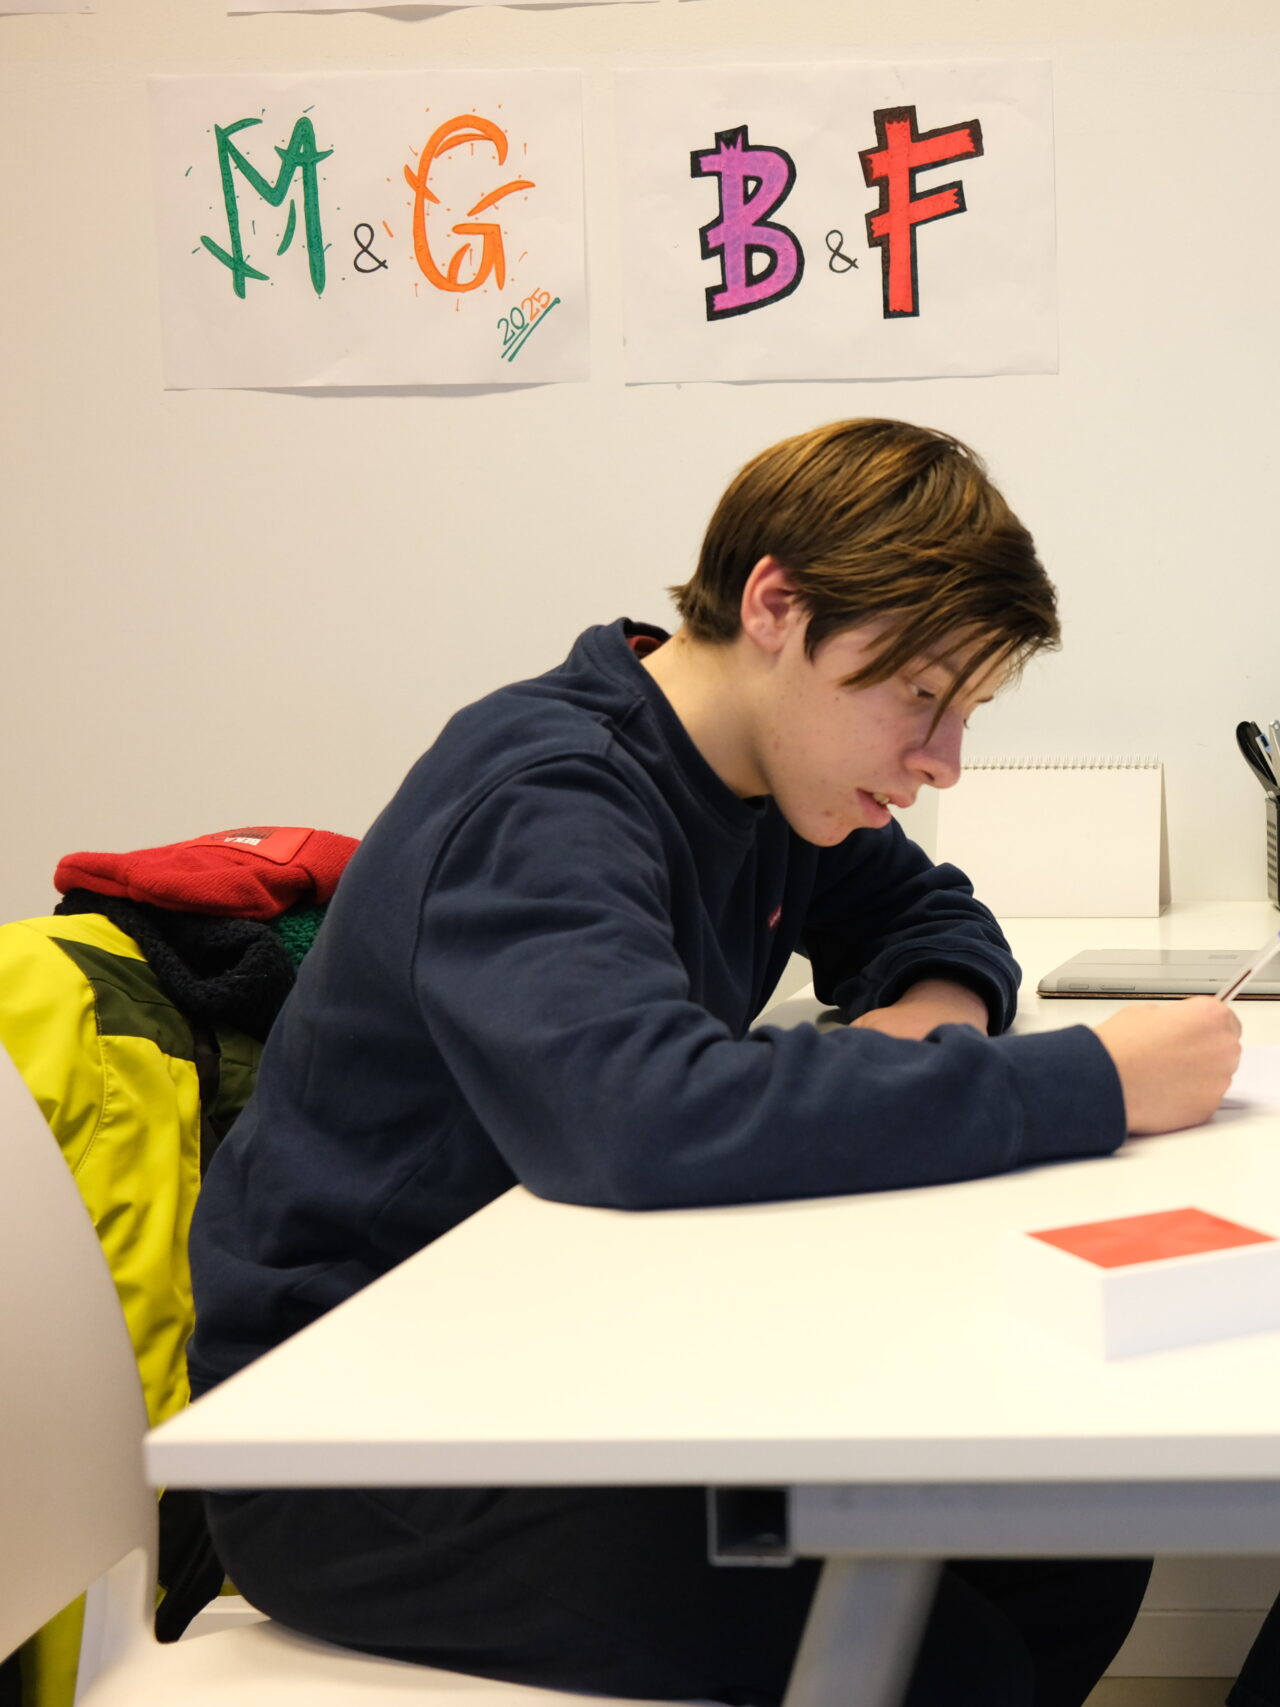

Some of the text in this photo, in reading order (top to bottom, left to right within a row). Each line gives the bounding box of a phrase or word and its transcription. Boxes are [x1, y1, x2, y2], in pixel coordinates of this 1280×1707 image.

[200, 113, 536, 299] M & G
[690, 105, 984, 321] B & F
[497, 287, 551, 346] 2025
